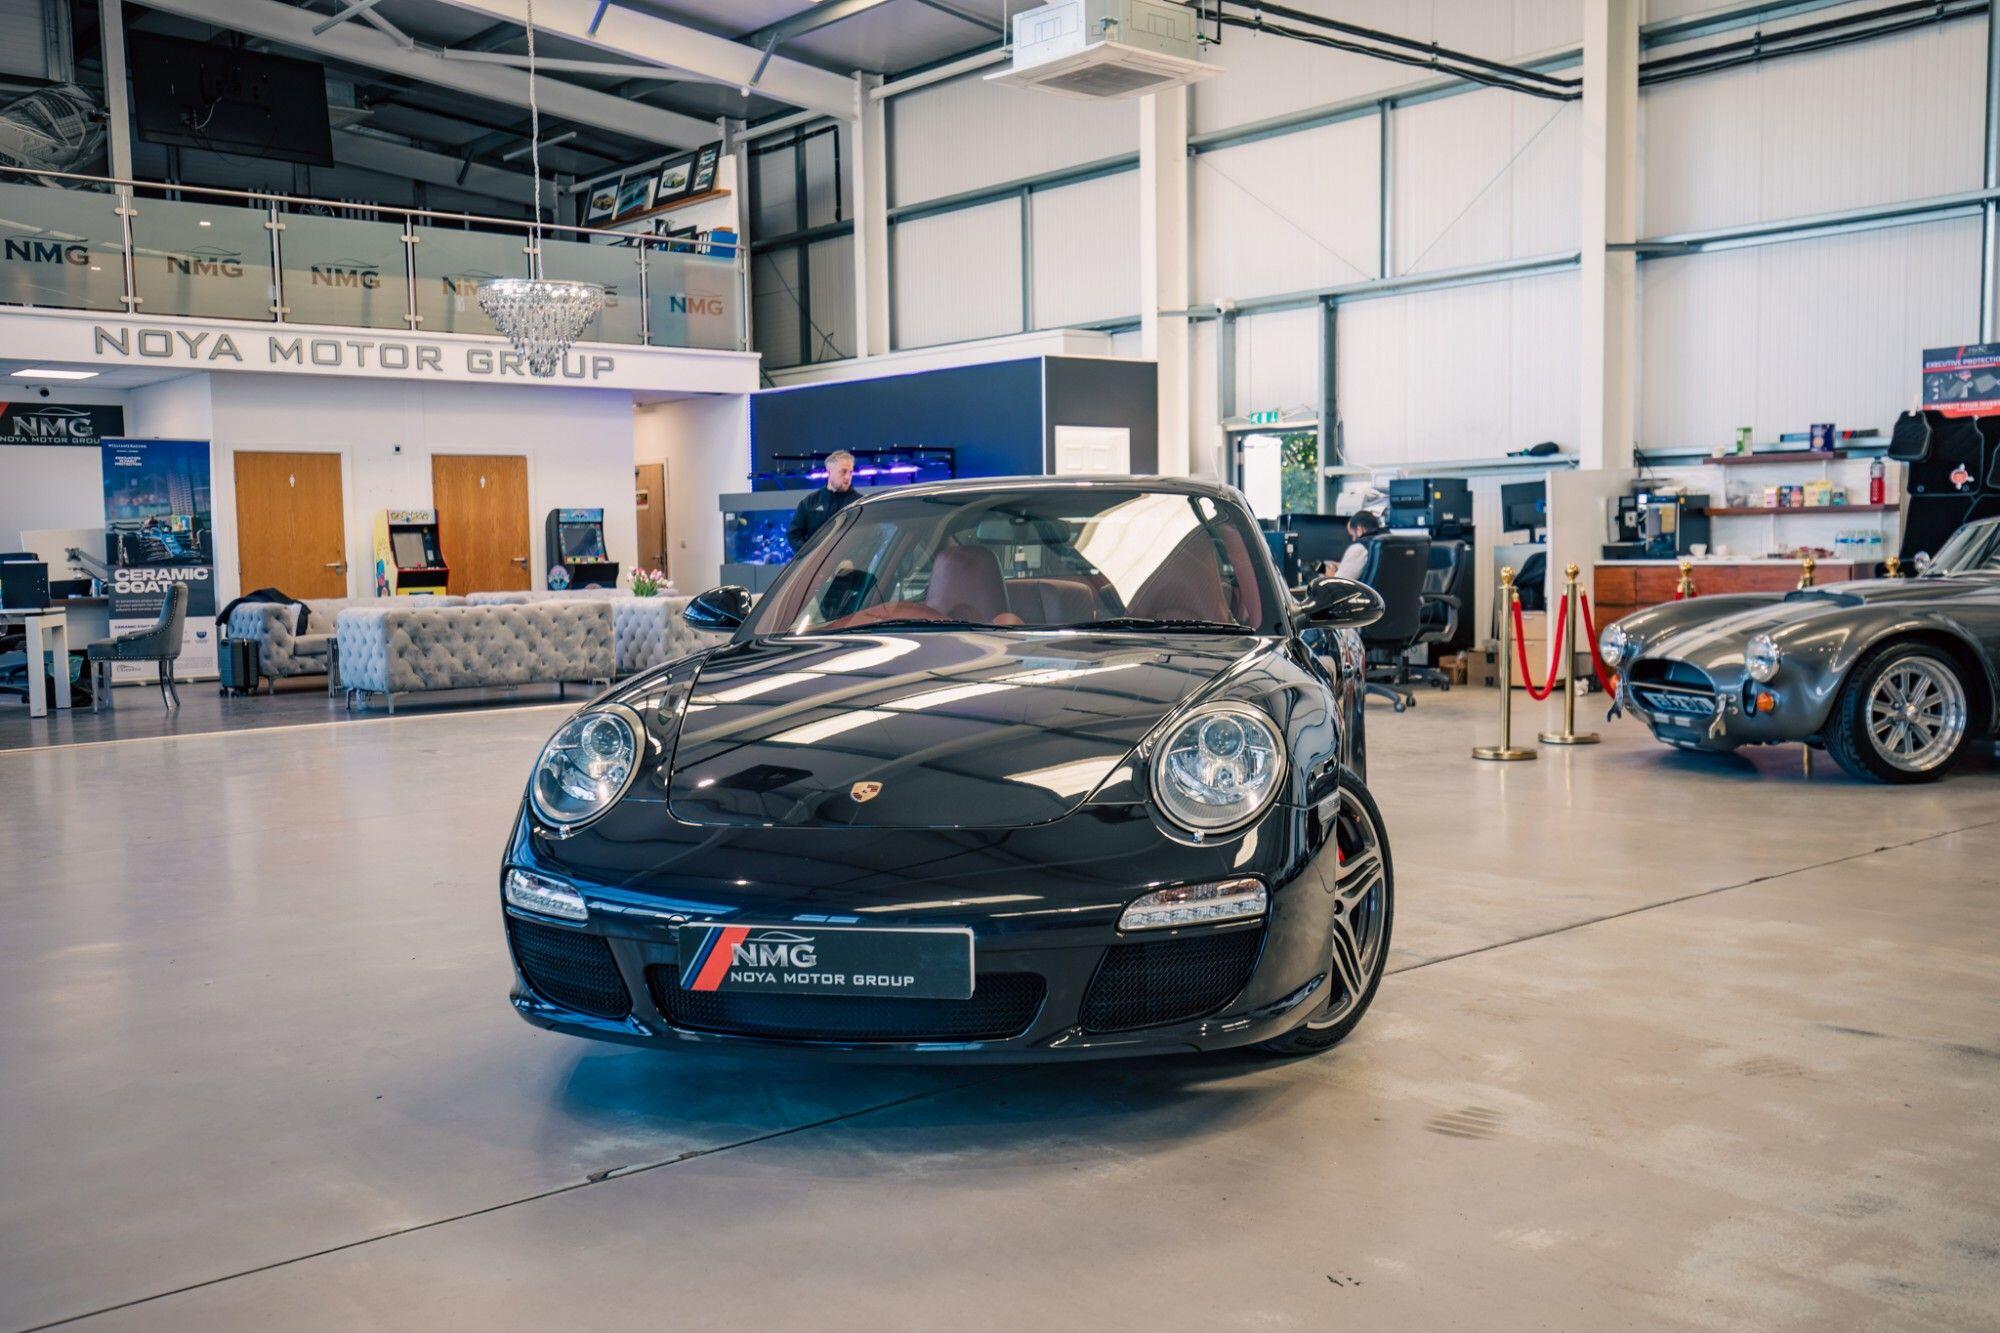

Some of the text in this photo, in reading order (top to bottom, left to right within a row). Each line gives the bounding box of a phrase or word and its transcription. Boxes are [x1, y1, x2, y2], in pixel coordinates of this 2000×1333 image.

[4, 238, 90, 266] NMG
[166, 255, 243, 278] NMG
[311, 265, 381, 289] NMG
[670, 295, 723, 316] NMG
[94, 325, 243, 362] NOYA
[268, 336, 443, 372] MOTOR
[1963, 356, 2000, 365] PROTECTIO
[12, 416, 94, 437] NMG
[0, 435, 27, 443] NOYA
[114, 567, 209, 581] CERAMIC
[115, 580, 173, 594] COAT
[731, 942, 817, 967] NMG
[730, 971, 915, 987] NOYA MOTOR GROUP
